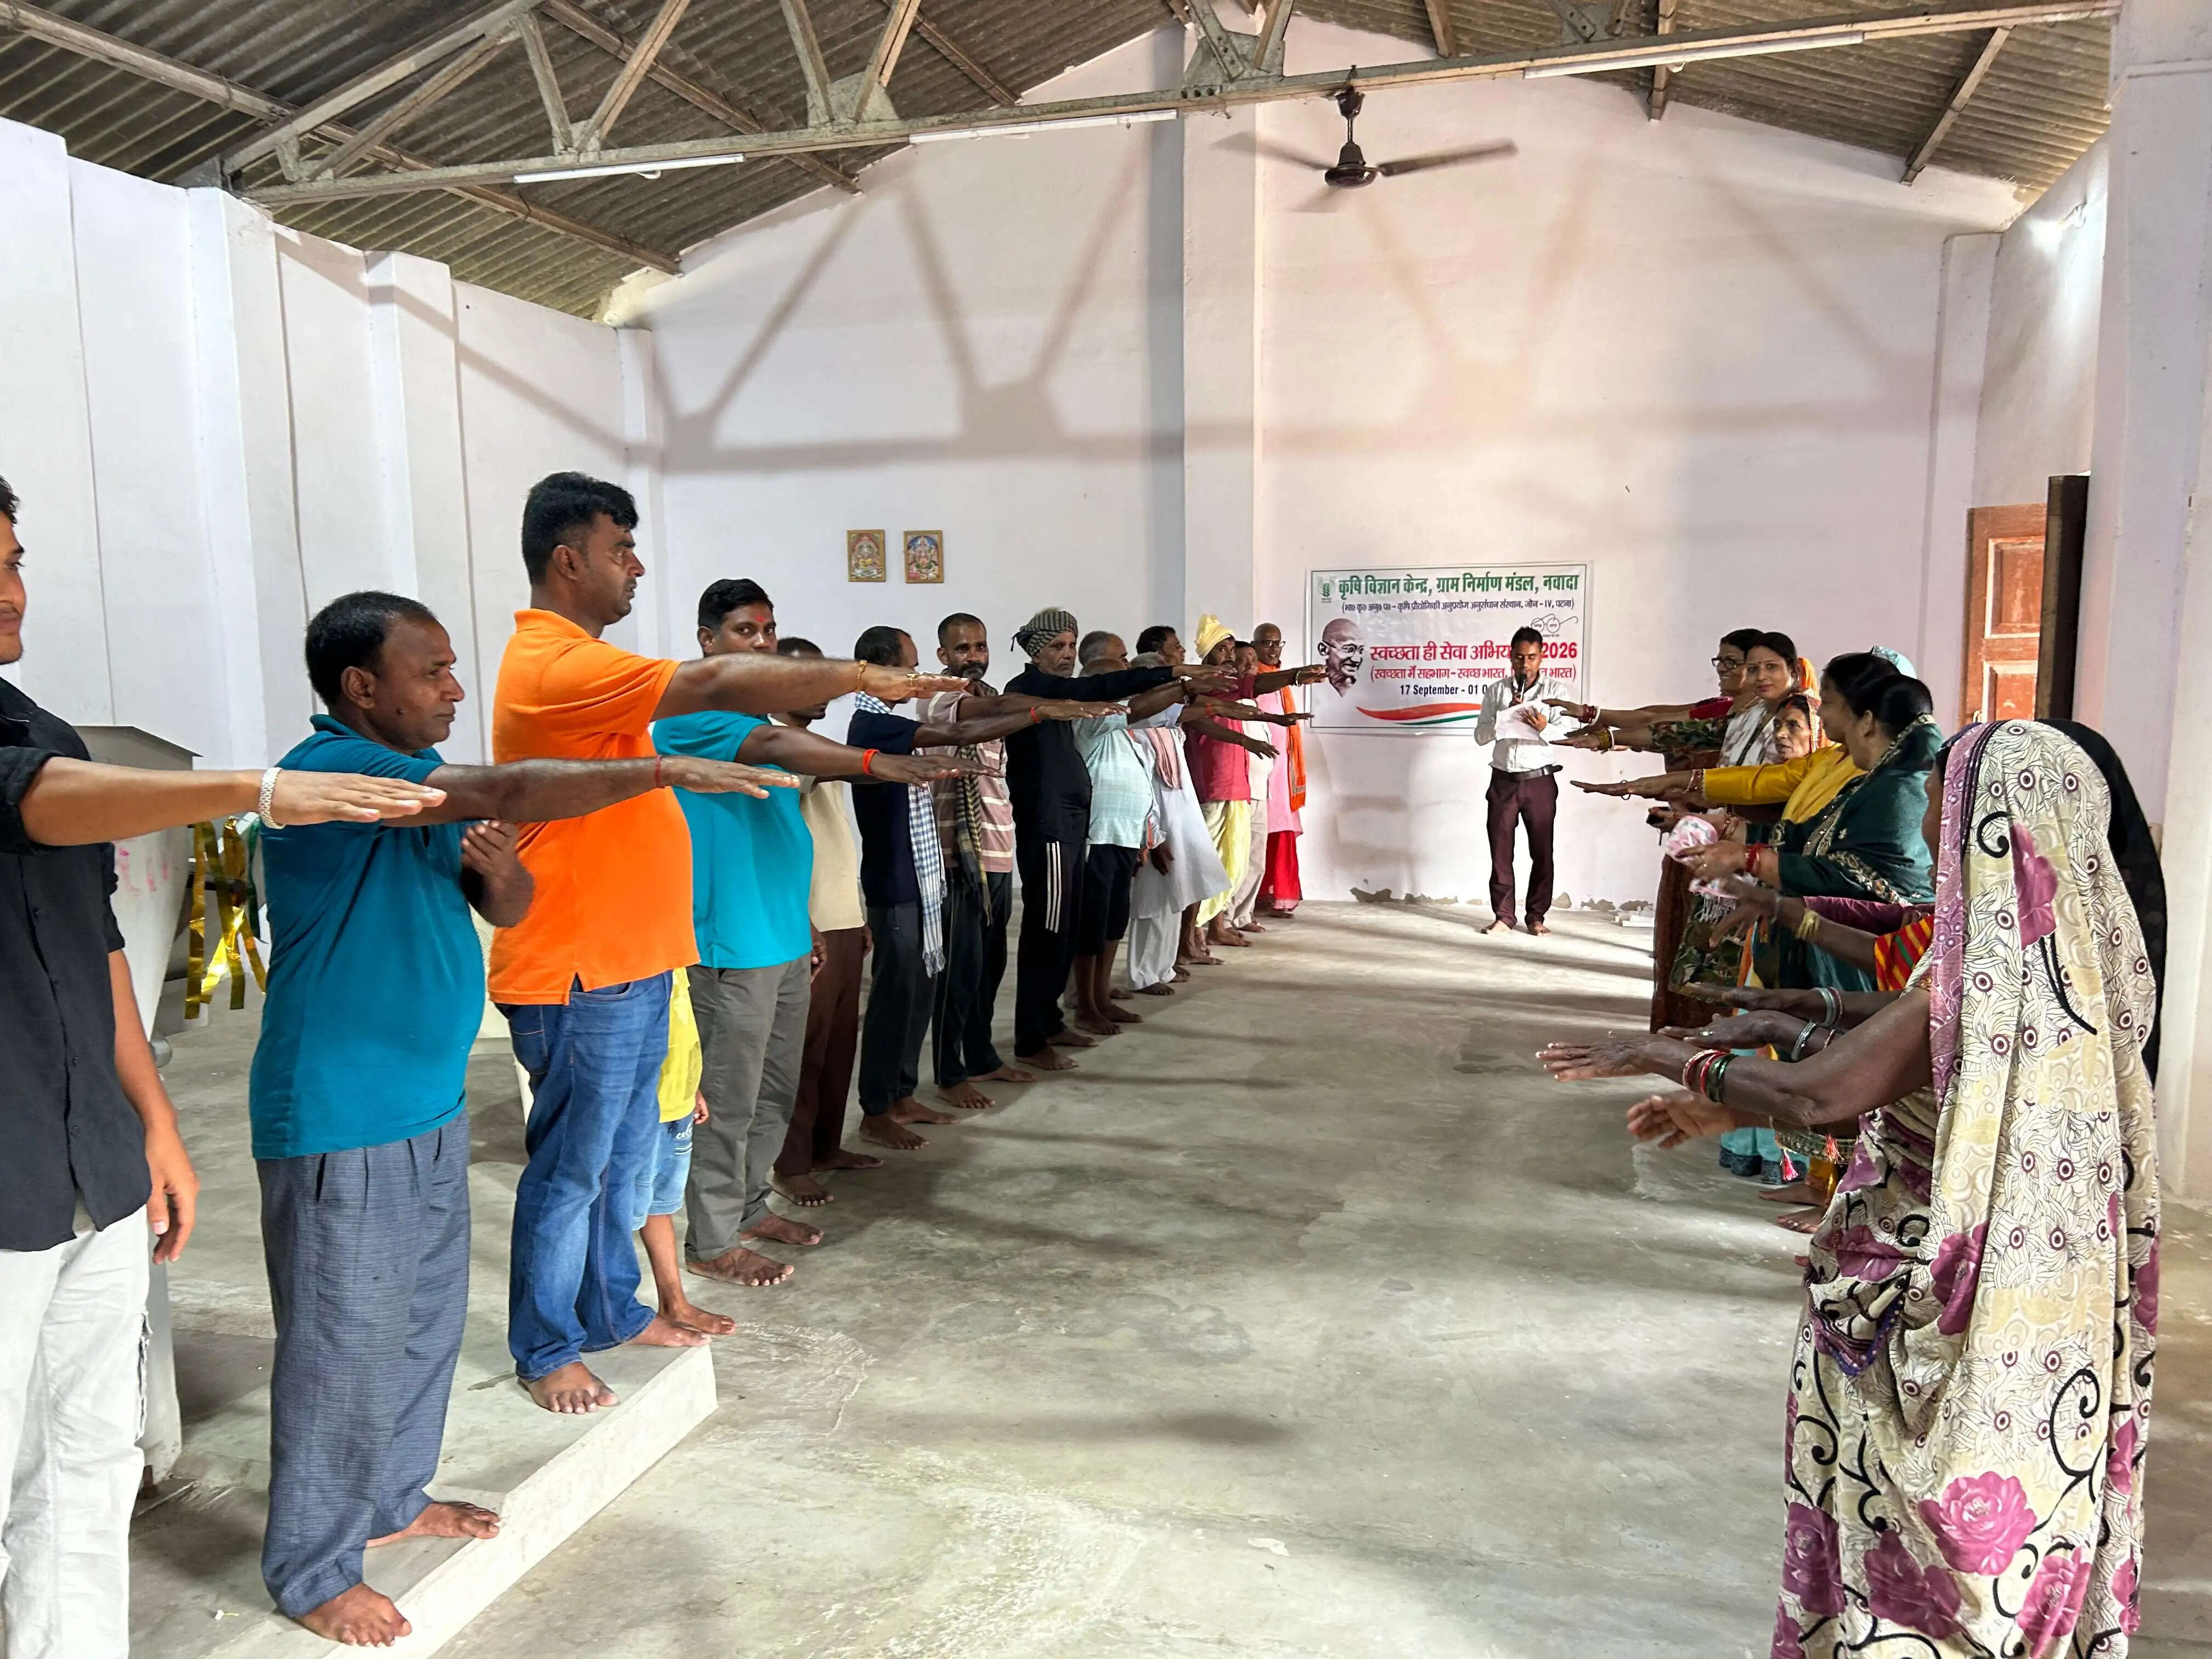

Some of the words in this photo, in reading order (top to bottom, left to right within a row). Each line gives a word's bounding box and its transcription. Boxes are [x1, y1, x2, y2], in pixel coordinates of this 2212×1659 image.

[1339, 575, 1362, 600] कृषि
[1365, 575, 1401, 594] विज्ञान
[1403, 574, 1432, 596] केन्द्र,
[1436, 578, 1460, 592] ग्राम
[1463, 572, 1503, 592] निर्माण
[1505, 572, 1538, 594] मंडल,
[1543, 575, 1579, 590] नवादा
[1398, 600, 1410, 612] कृषि
[1441, 600, 1469, 612] अनुप्रयोग
[1470, 599, 1498, 612] अनुसंधान
[1525, 599, 1538, 608] जोन
[1545, 600, 1554, 608] IV,
[1370, 645, 1420, 661] स्वच्छता
[1423, 641, 1437, 661] ही
[1440, 641, 1468, 660] सेवा
[1470, 640, 1511, 659] अभिय
[1542, 642, 1577, 658] 2026
[1370, 665, 1406, 682] (स्वच्छता
[1407, 665, 1416, 679] में
[1457, 668, 1481, 679] स्वच्छ
[1549, 663, 1576, 682] भारत)
[1400, 685, 1410, 695] 17
[1413, 685, 1458, 697] September
[1468, 684, 1478, 695] 01
